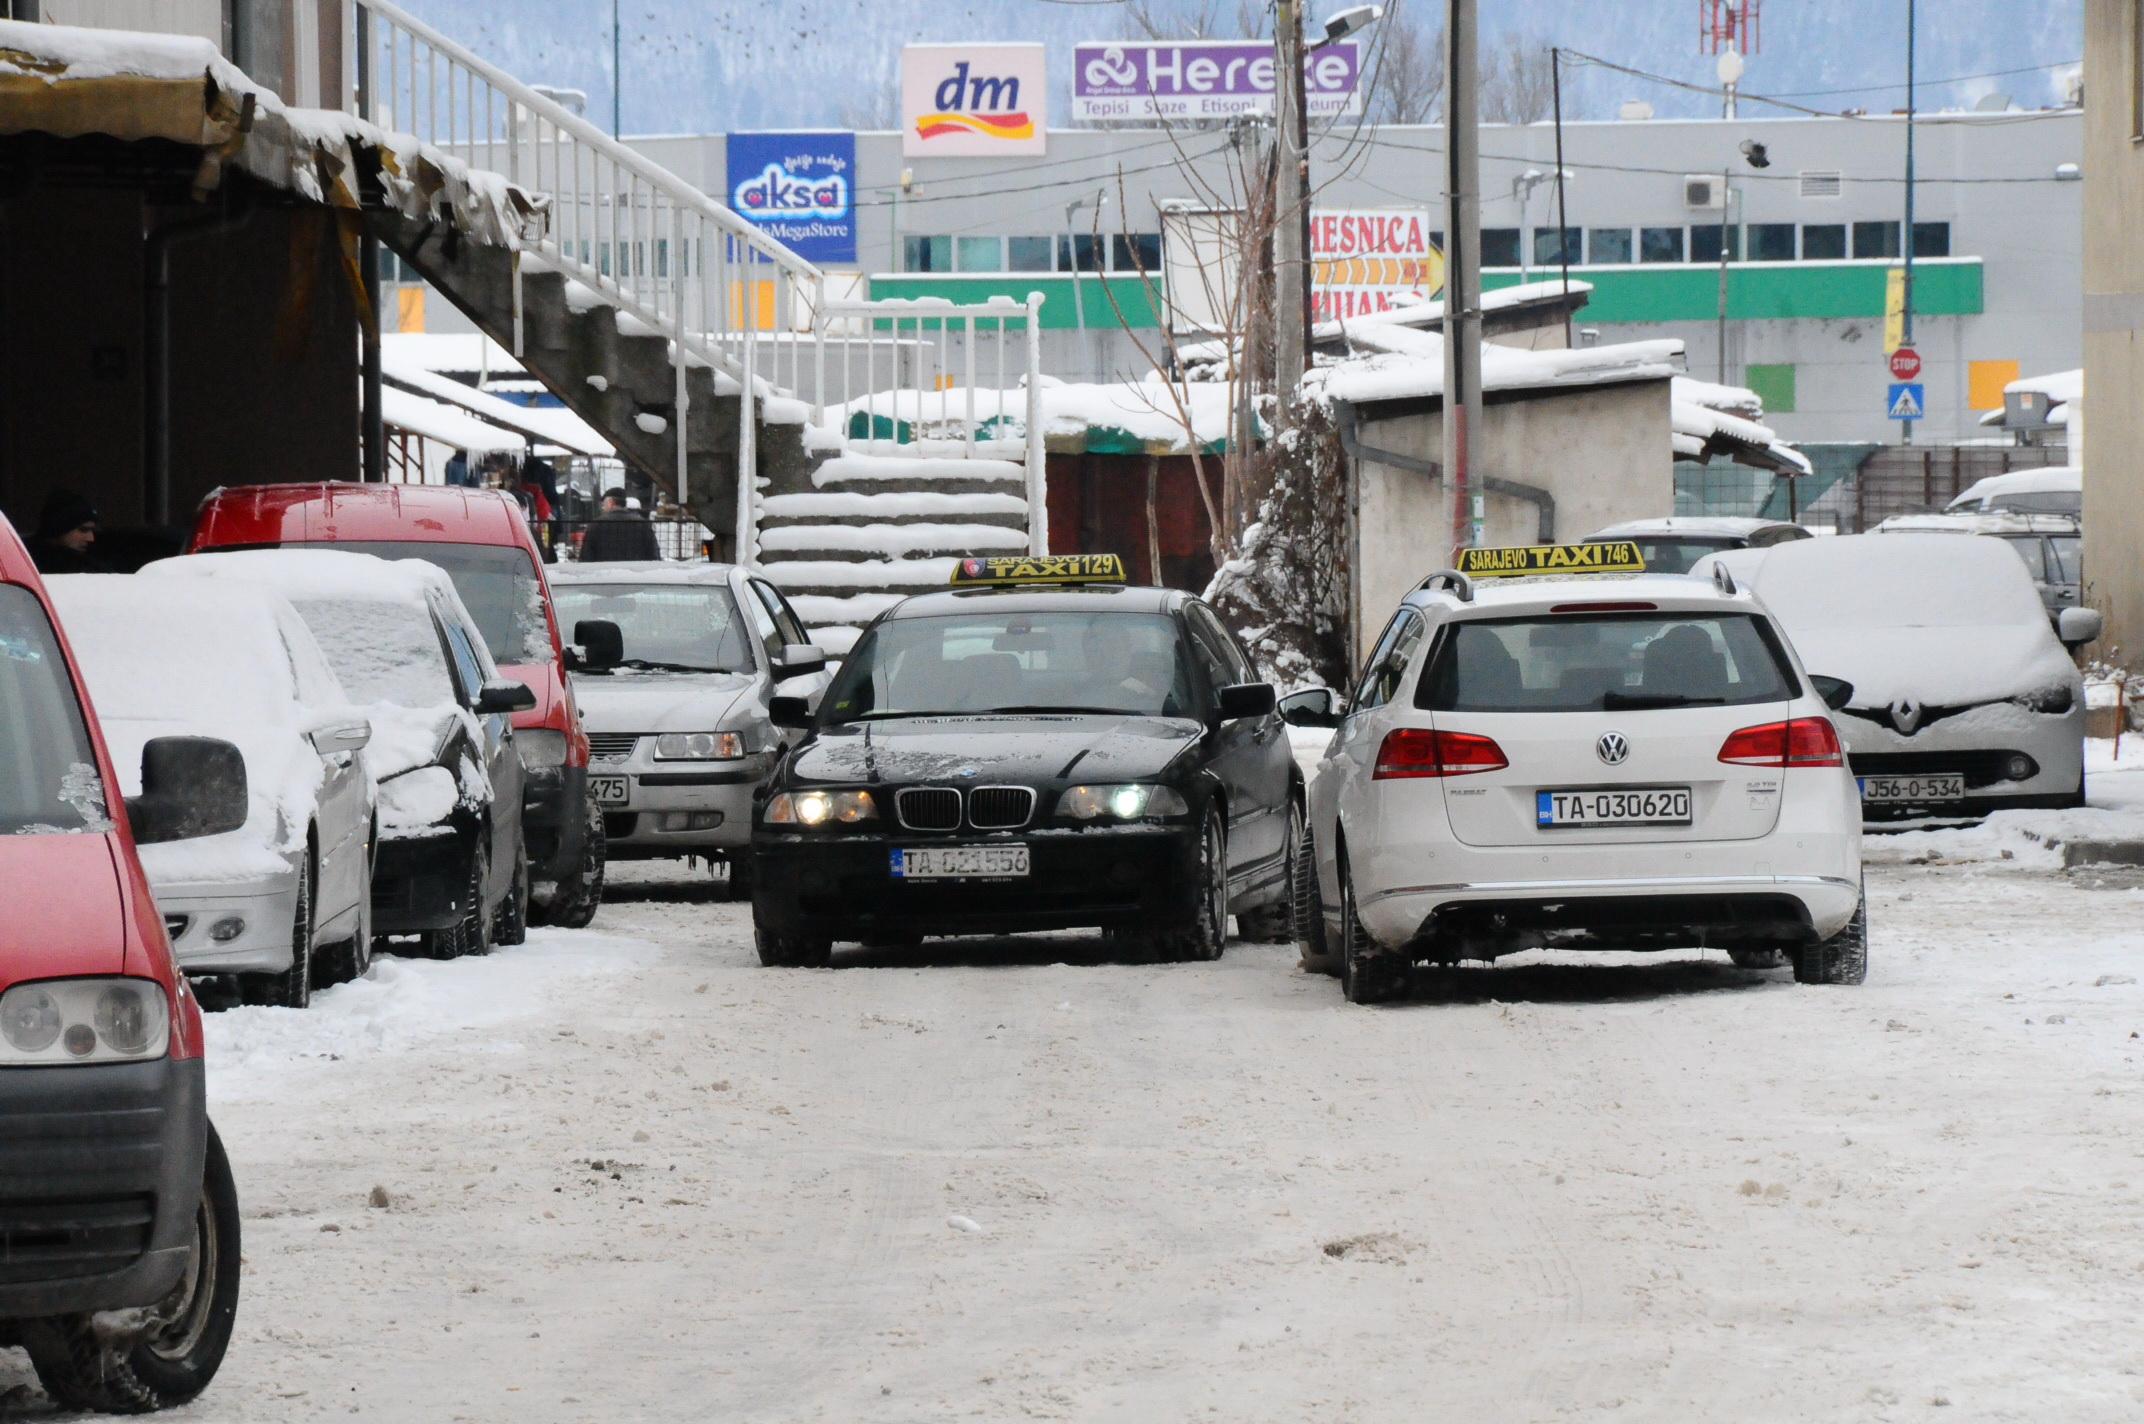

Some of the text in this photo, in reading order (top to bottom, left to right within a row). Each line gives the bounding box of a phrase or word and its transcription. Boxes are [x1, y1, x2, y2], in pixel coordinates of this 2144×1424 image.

[935, 61, 1020, 112] dm
[1083, 100, 1130, 117] Tepisi
[742, 171, 839, 209] aksa
[1892, 357, 1919, 371] STOP
[986, 556, 1080, 566] SARAJEVO
[986, 554, 1114, 577] TAXI 129
[1469, 544, 1630, 570] SARAJEVO TAXI 746
[1552, 793, 1689, 820] TA-030620
